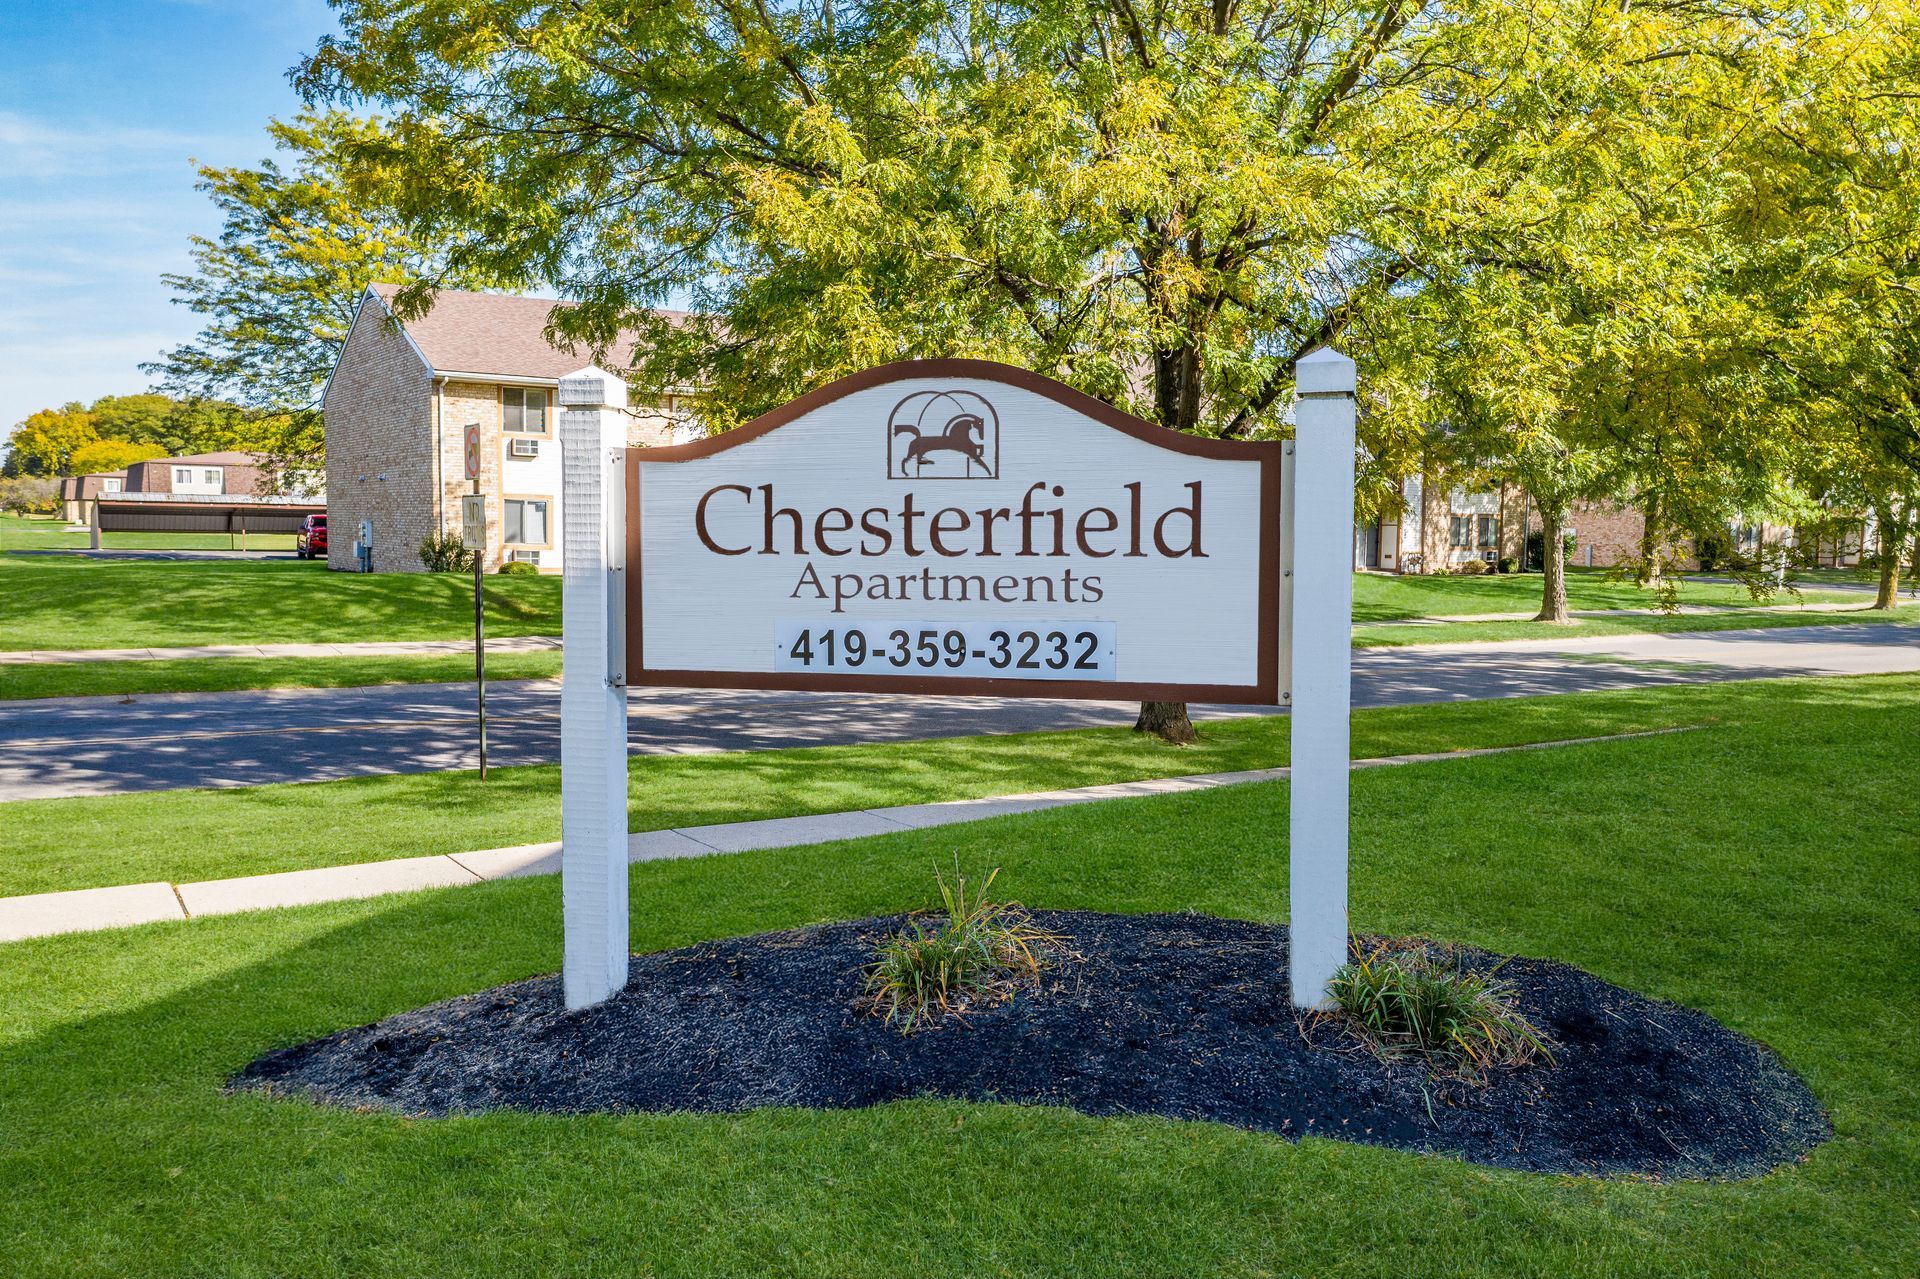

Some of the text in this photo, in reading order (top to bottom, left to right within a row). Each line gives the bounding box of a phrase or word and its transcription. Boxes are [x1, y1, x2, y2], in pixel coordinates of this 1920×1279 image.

[468, 502, 480, 522] NO
[695, 480, 1210, 559] Chesterfield
[464, 525, 485, 543] TRUS
[789, 561, 1104, 614] Apartments
[789, 629, 1100, 670] 419-359-3232
